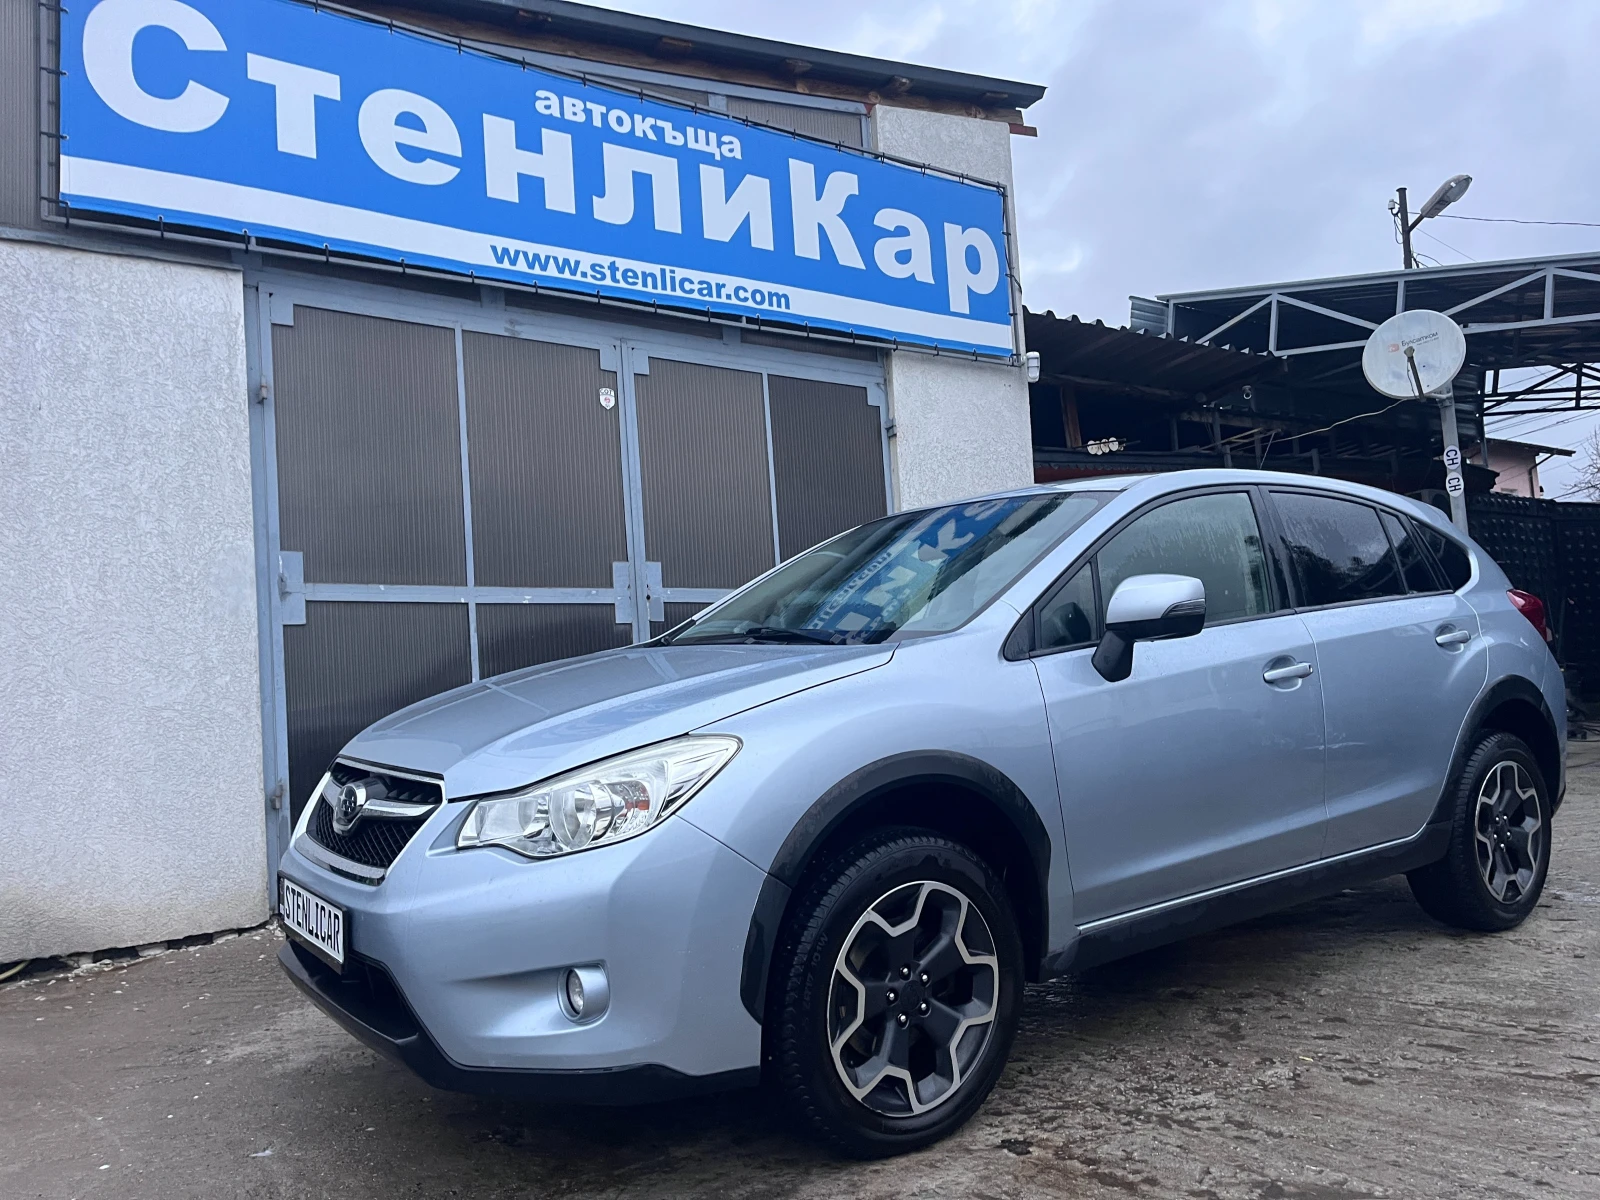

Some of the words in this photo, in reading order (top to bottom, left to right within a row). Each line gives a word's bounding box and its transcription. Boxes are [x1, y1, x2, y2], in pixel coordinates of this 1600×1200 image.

[82, 0, 1000, 314] СтенлиКар
[534, 89, 742, 161] автокъща
[490, 244, 791, 312] www.stenlicar.com
[1446, 449, 1459, 466] CH
[1448, 477, 1461, 492] CH
[285, 884, 341, 954] STENLICAR
